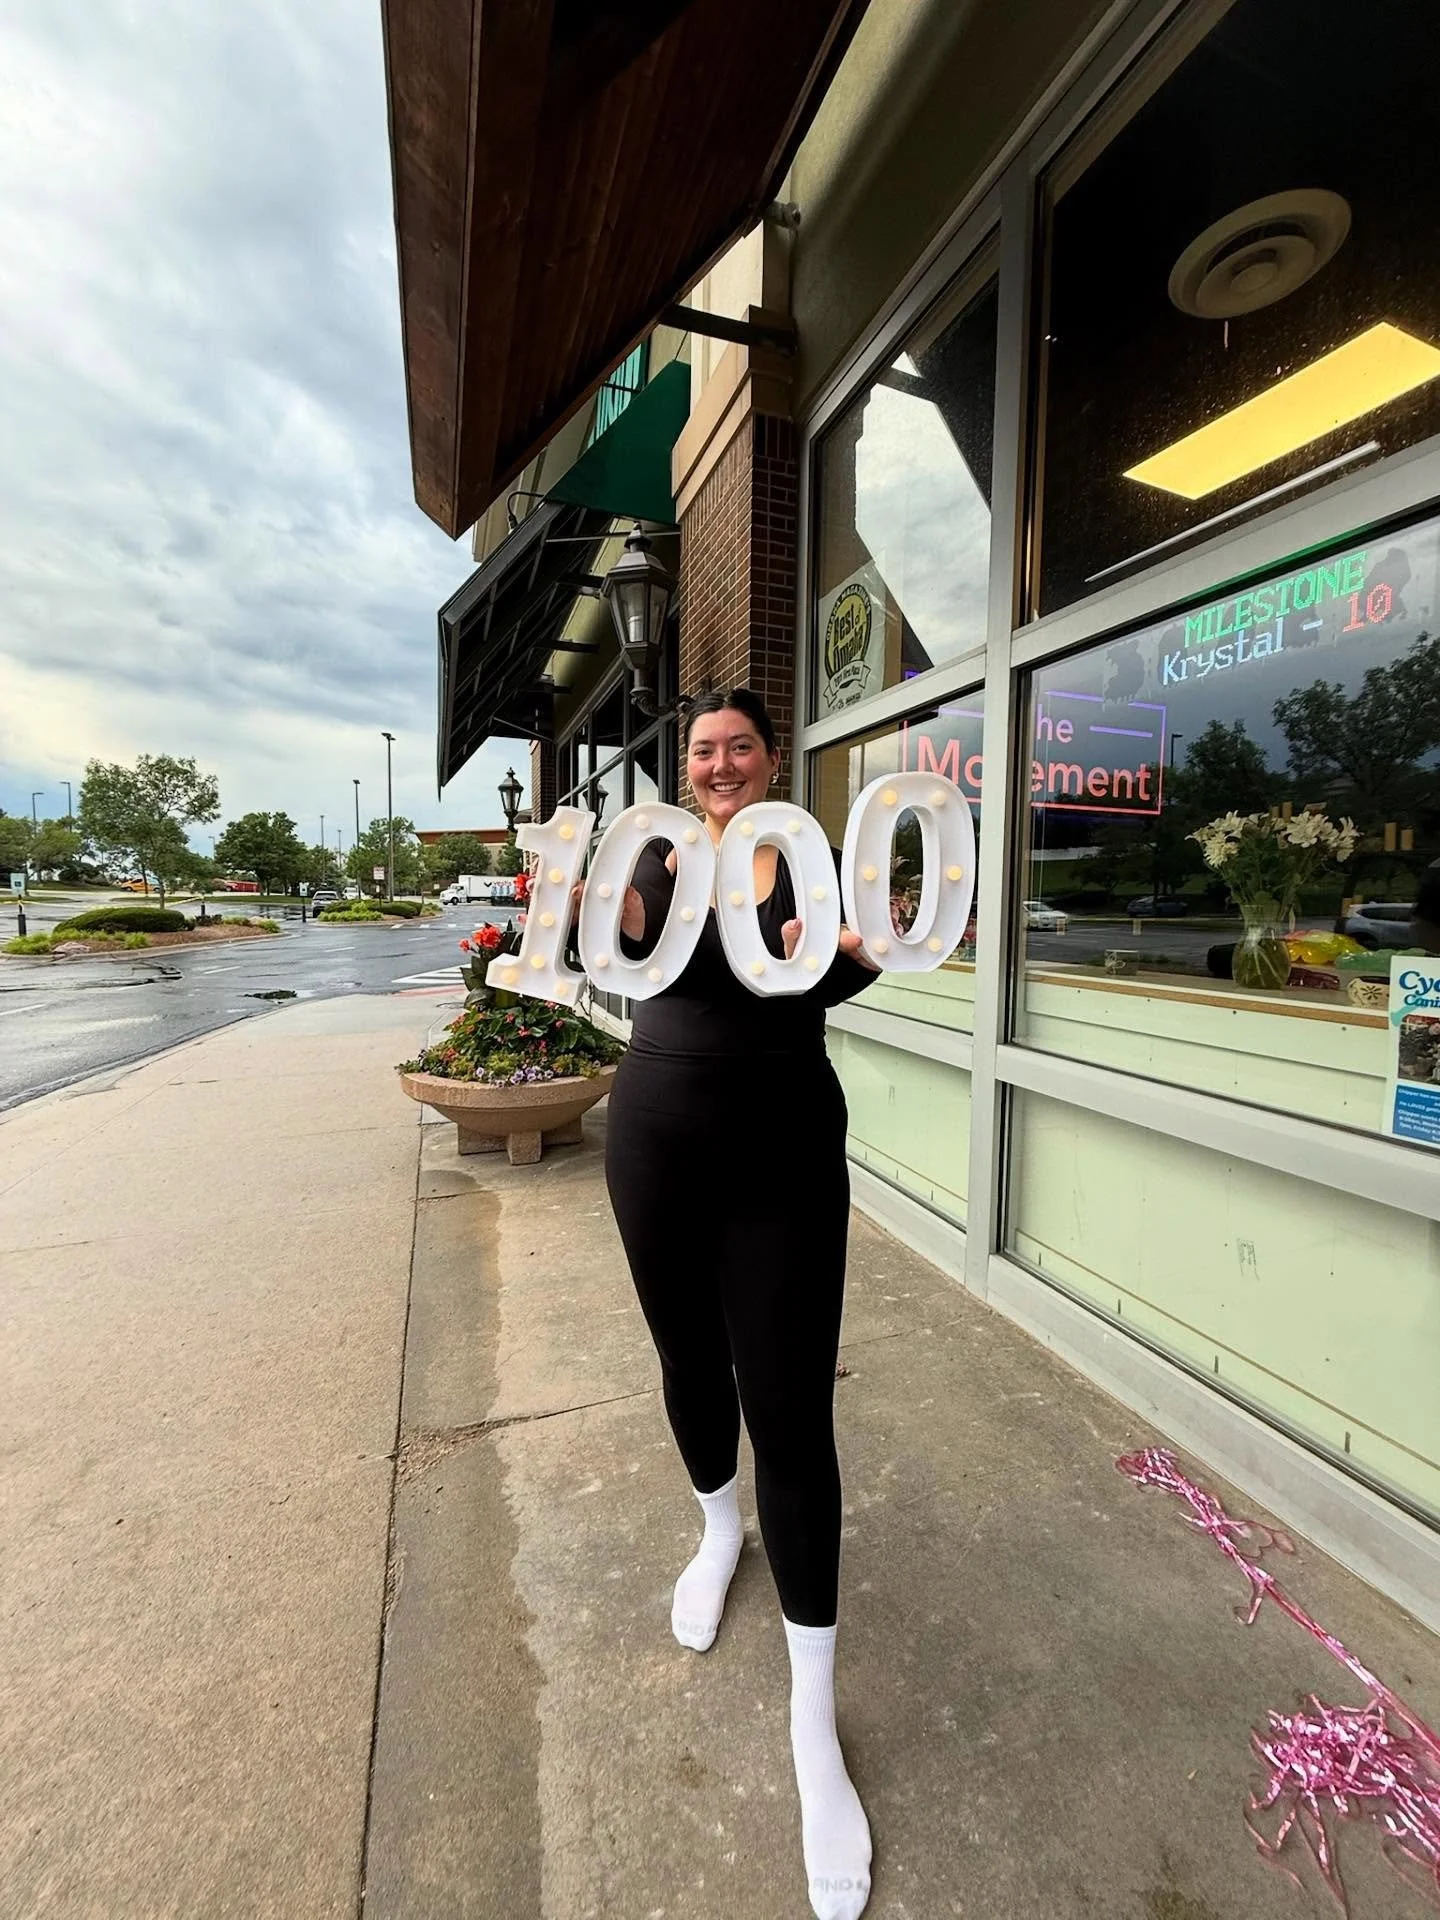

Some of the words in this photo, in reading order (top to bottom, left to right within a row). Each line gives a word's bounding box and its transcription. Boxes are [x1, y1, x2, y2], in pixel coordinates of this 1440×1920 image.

[1162, 617, 1284, 685] Krystal
[1342, 583, 1393, 633] 10
[1184, 551, 1367, 648] MILESTONE
[918, 735, 1151, 800] Moement
[1036, 704, 1074, 743] he
[486, 771, 976, 1001] 1000
